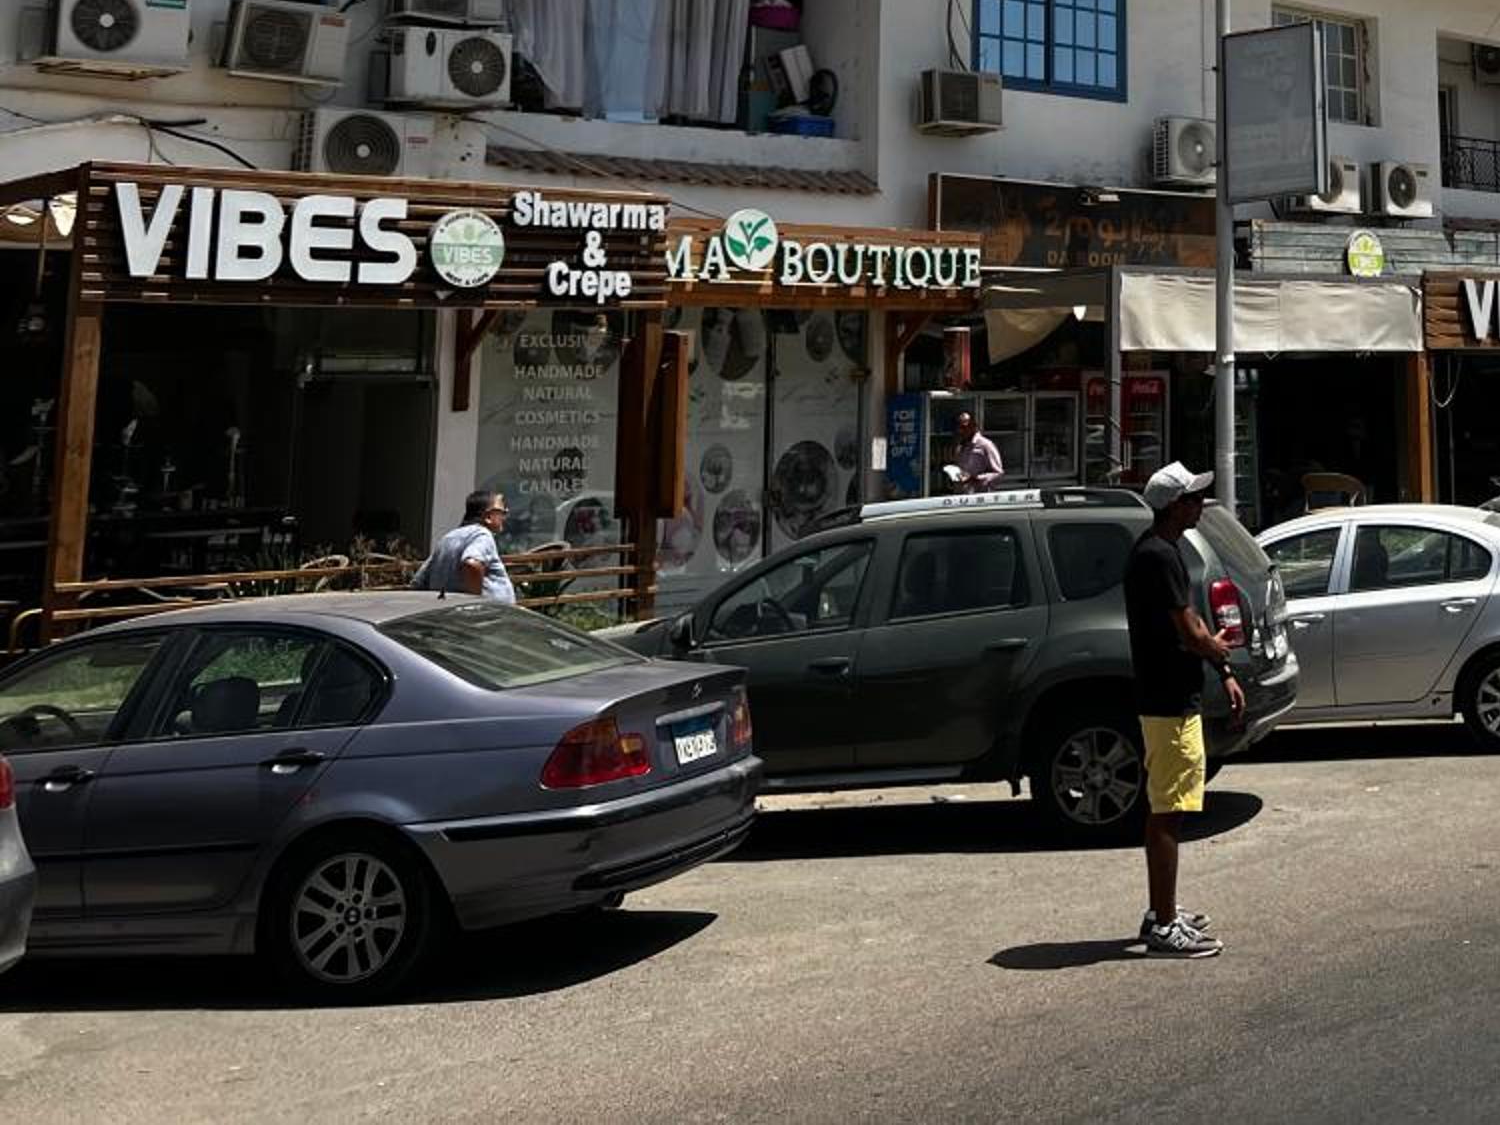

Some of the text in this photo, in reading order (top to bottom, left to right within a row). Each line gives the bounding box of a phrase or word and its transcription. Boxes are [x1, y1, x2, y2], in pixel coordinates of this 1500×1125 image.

[512, 190, 666, 231] Shawarma
[115, 181, 418, 285] VIBES
[443, 245, 494, 265] VIBES
[582, 230, 608, 268] &
[780, 240, 982, 289] BOUTIQUE
[514, 365, 605, 380] HANDMADE
[523, 386, 593, 401] NATURAL
[514, 410, 601, 425] COSMETICS
[510, 435, 600, 452] HANDMADE
[519, 457, 591, 473] NATURAL
